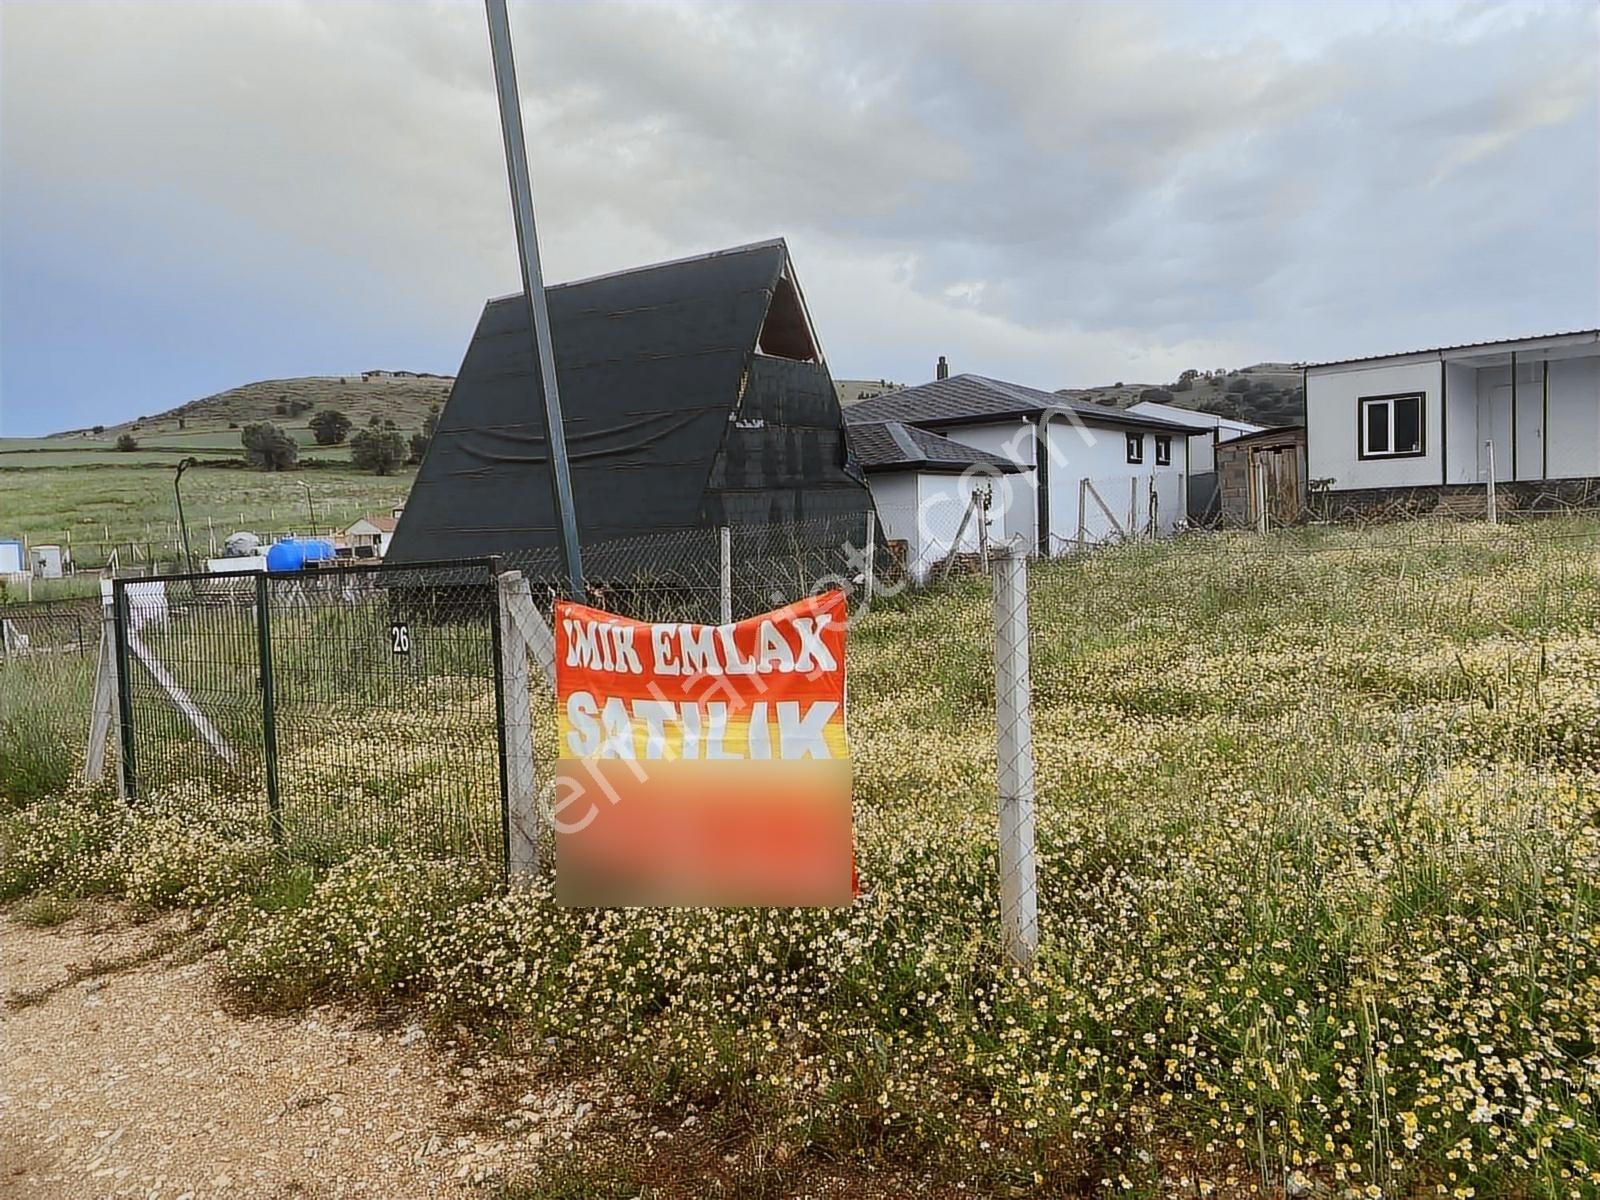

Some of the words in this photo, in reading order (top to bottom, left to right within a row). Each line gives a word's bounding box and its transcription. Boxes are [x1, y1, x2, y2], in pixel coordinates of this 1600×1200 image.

[392, 626, 409, 652] 26
[651, 613, 837, 675] EMLAK
[566, 691, 840, 760] SATILIK
